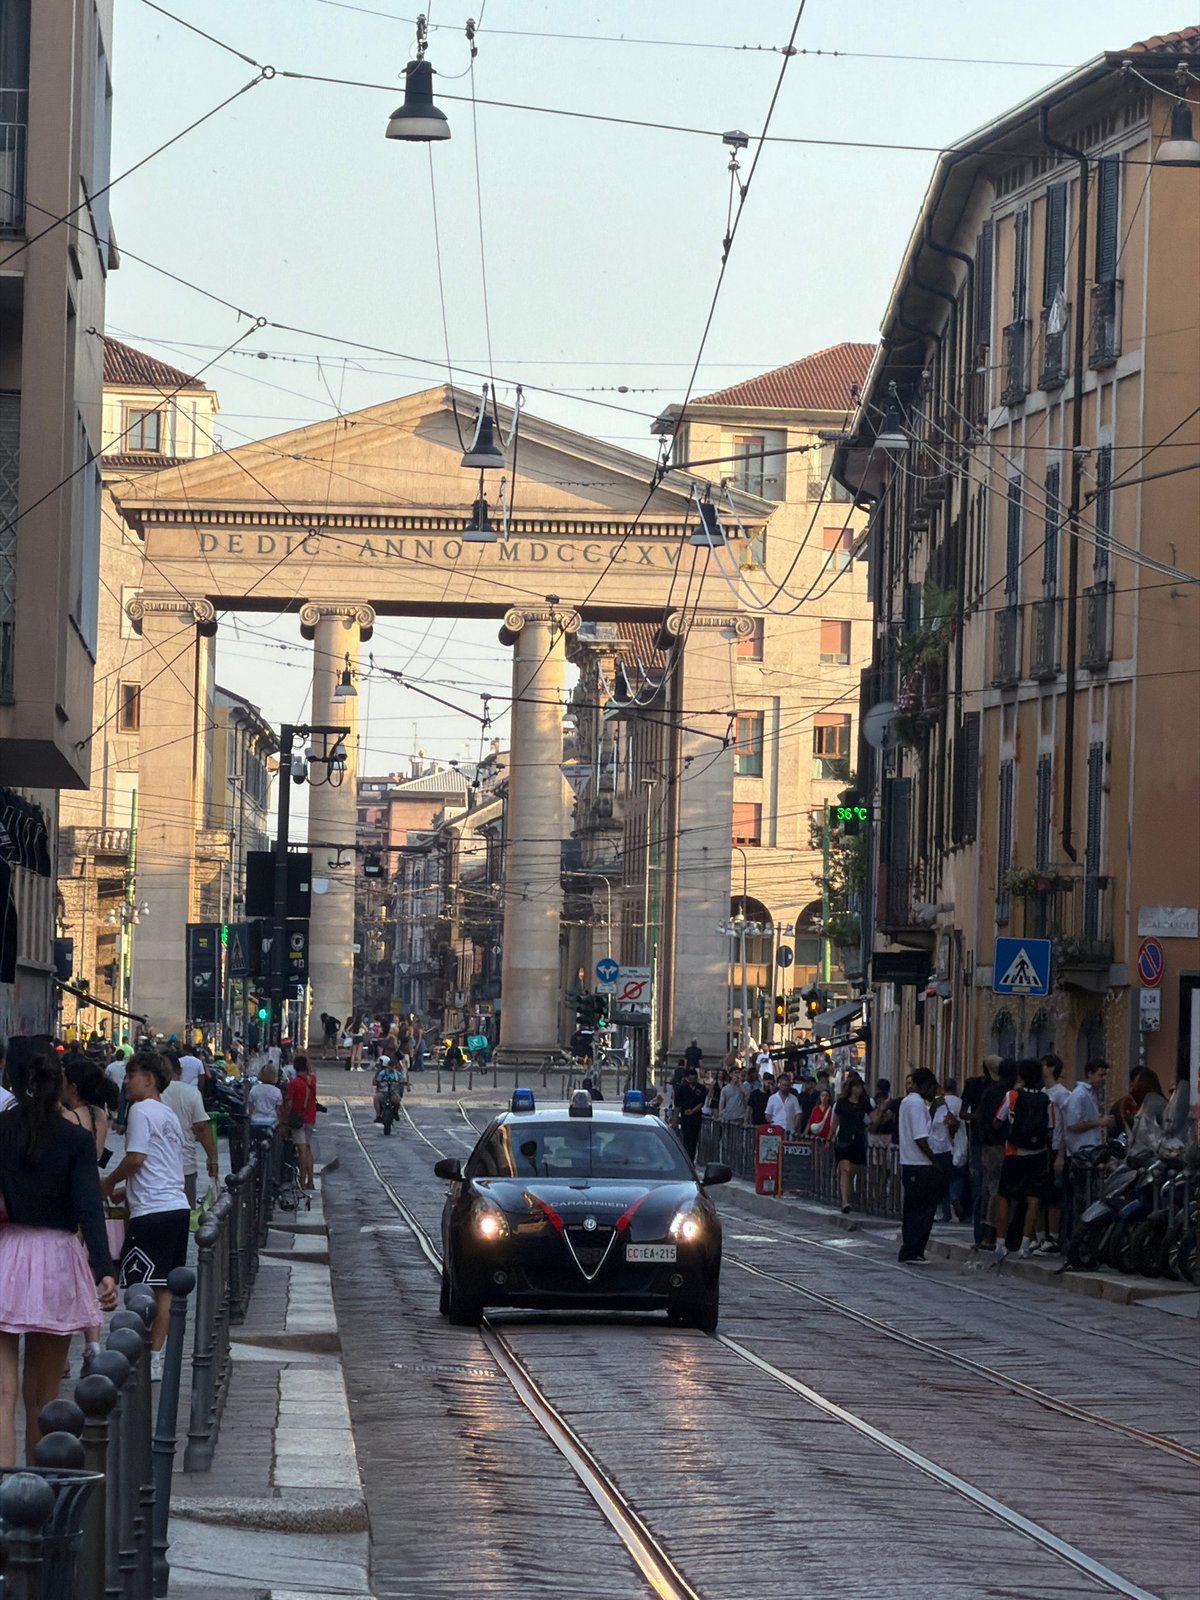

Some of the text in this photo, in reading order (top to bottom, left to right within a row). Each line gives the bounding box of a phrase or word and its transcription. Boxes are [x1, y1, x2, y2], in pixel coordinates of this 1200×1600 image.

[199, 532, 682, 565] DEDIC ANNO MDCCCXV
[550, 1200, 628, 1209] CARABINIERI
[659, 1248, 676, 1259] 215
